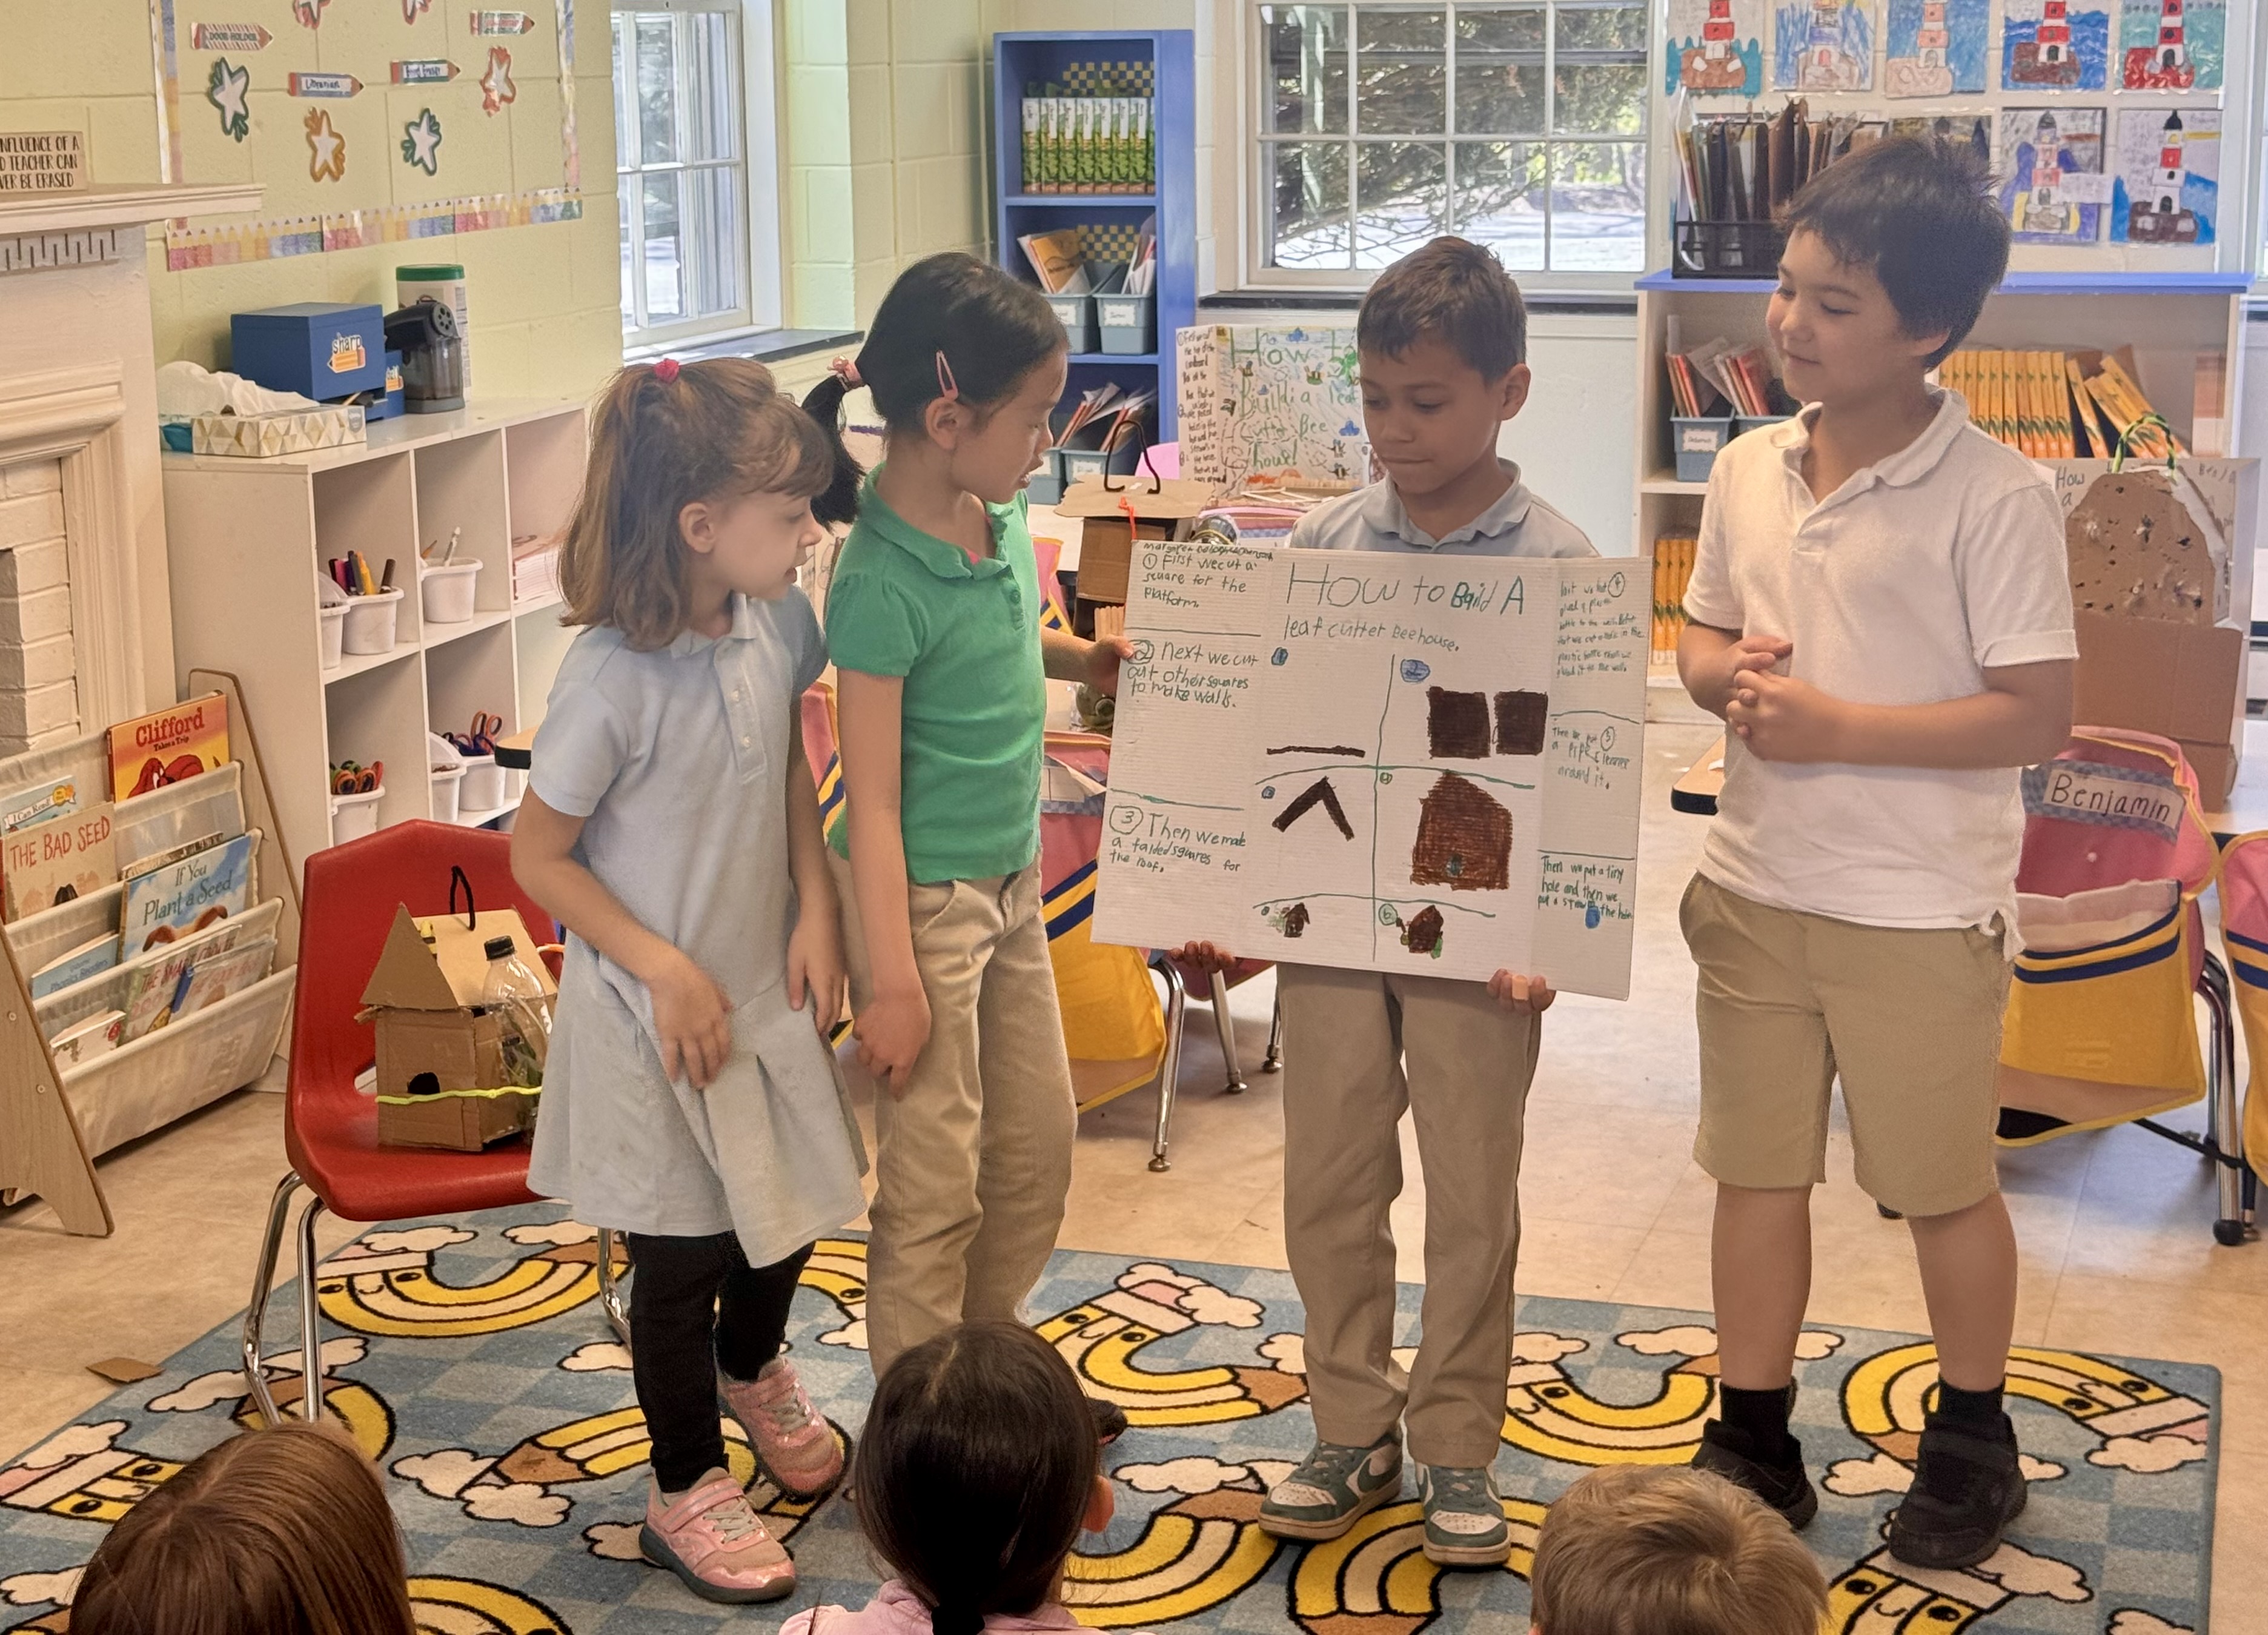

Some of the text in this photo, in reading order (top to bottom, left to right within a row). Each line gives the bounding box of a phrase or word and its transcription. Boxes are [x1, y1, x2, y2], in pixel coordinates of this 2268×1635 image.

[55, 135, 68, 151] OF
[73, 135, 80, 151] A
[8, 154, 55, 171] TEACHER
[56, 153, 78, 170] CAN
[20, 173, 33, 189] BE
[36, 171, 74, 188] ERASED
[333, 332, 362, 354] sharp
[1230, 327, 1311, 370] How
[1301, 392, 1313, 406] a
[1299, 413, 1328, 442] Bee
[2055, 466, 2085, 491] How
[2061, 491, 2073, 508] a
[1162, 554, 1193, 571] First
[1192, 574, 1213, 586] for
[1222, 575, 1247, 593] the
[1413, 575, 1446, 606] to
[1500, 575, 1525, 616] A
[1284, 614, 1324, 641] leaf
[1327, 619, 1387, 640] cutter
[1208, 651, 1231, 665] we
[1233, 654, 1260, 666] cut
[1131, 678, 1146, 697] to
[1151, 681, 1190, 702] make
[136, 706, 205, 748] Clifford
[2051, 773, 2170, 823] Benjamin
[13, 814, 17, 823] I
[18, 810, 32, 821] Can
[1149, 812, 1191, 843] Then
[10, 815, 111, 873] THE BAD SEED
[1112, 836, 1122, 848] a
[1222, 858, 1241, 872] for
[1109, 849, 1130, 864] the
[174, 858, 207, 887] If You
[1541, 855, 1563, 874] Then
[1606, 864, 1625, 884] tiny
[142, 869, 234, 926] Plant a Seed
[1563, 879, 1580, 898] and
[1582, 884, 1603, 901] then
